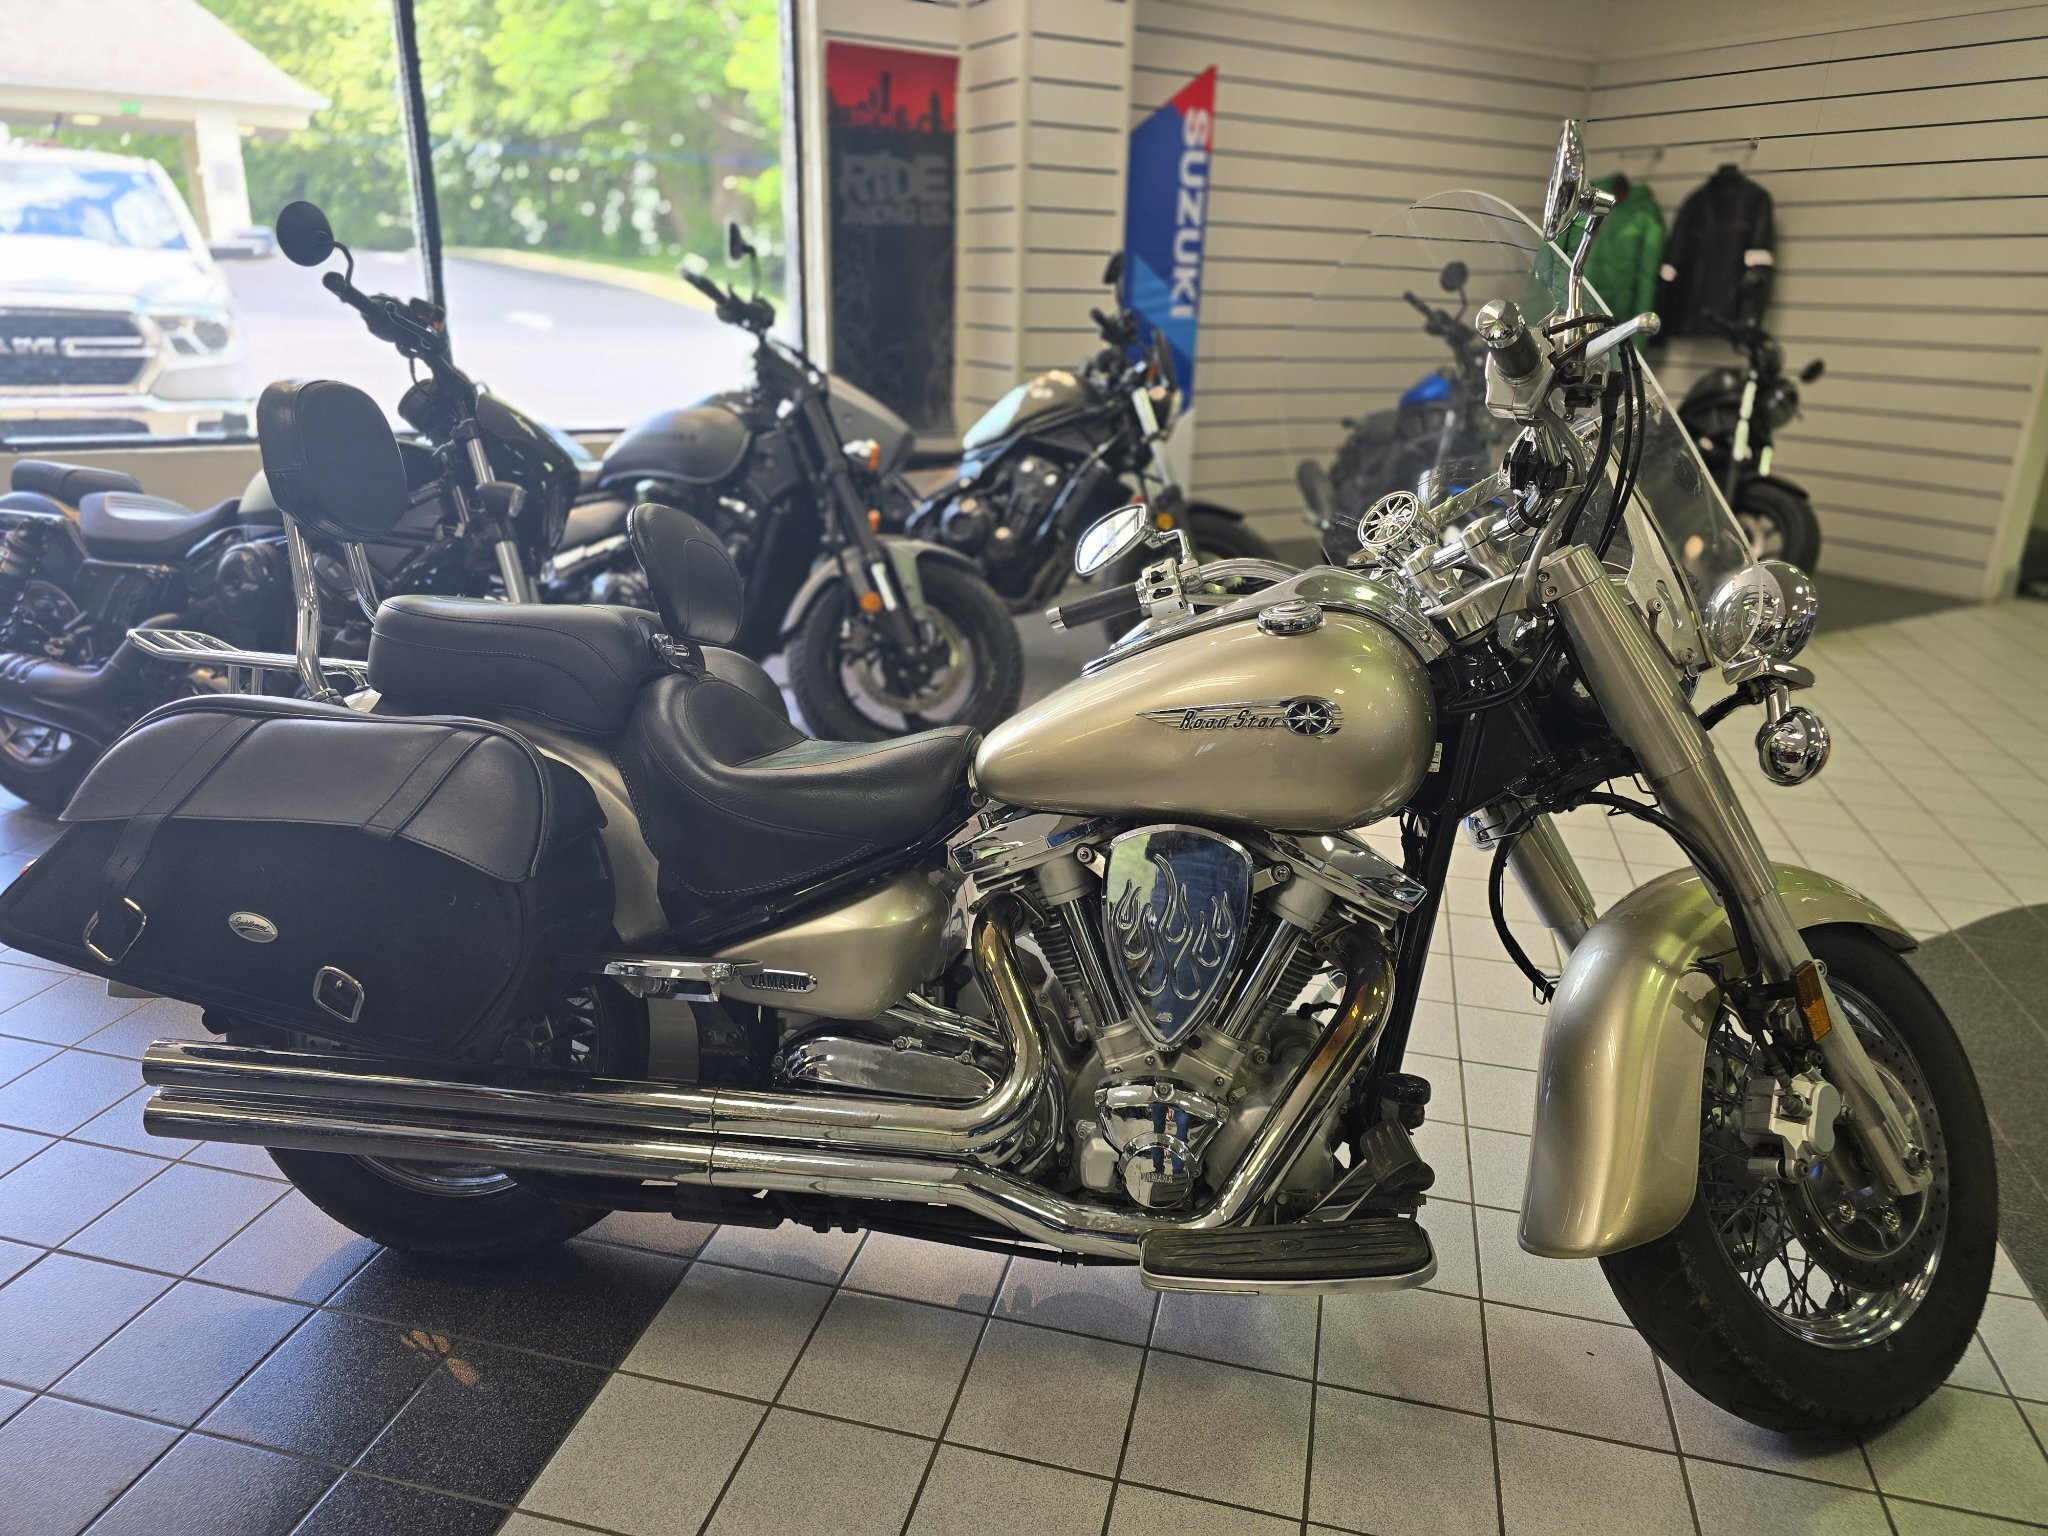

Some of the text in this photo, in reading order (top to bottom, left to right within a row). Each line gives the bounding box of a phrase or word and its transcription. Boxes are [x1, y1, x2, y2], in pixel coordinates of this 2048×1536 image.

[1169, 106, 1210, 319] SUZUKI
[1179, 708, 1281, 730] Road Star
[751, 974, 808, 991] YAMAHA
[1140, 1172, 1173, 1184] YAMAHA
